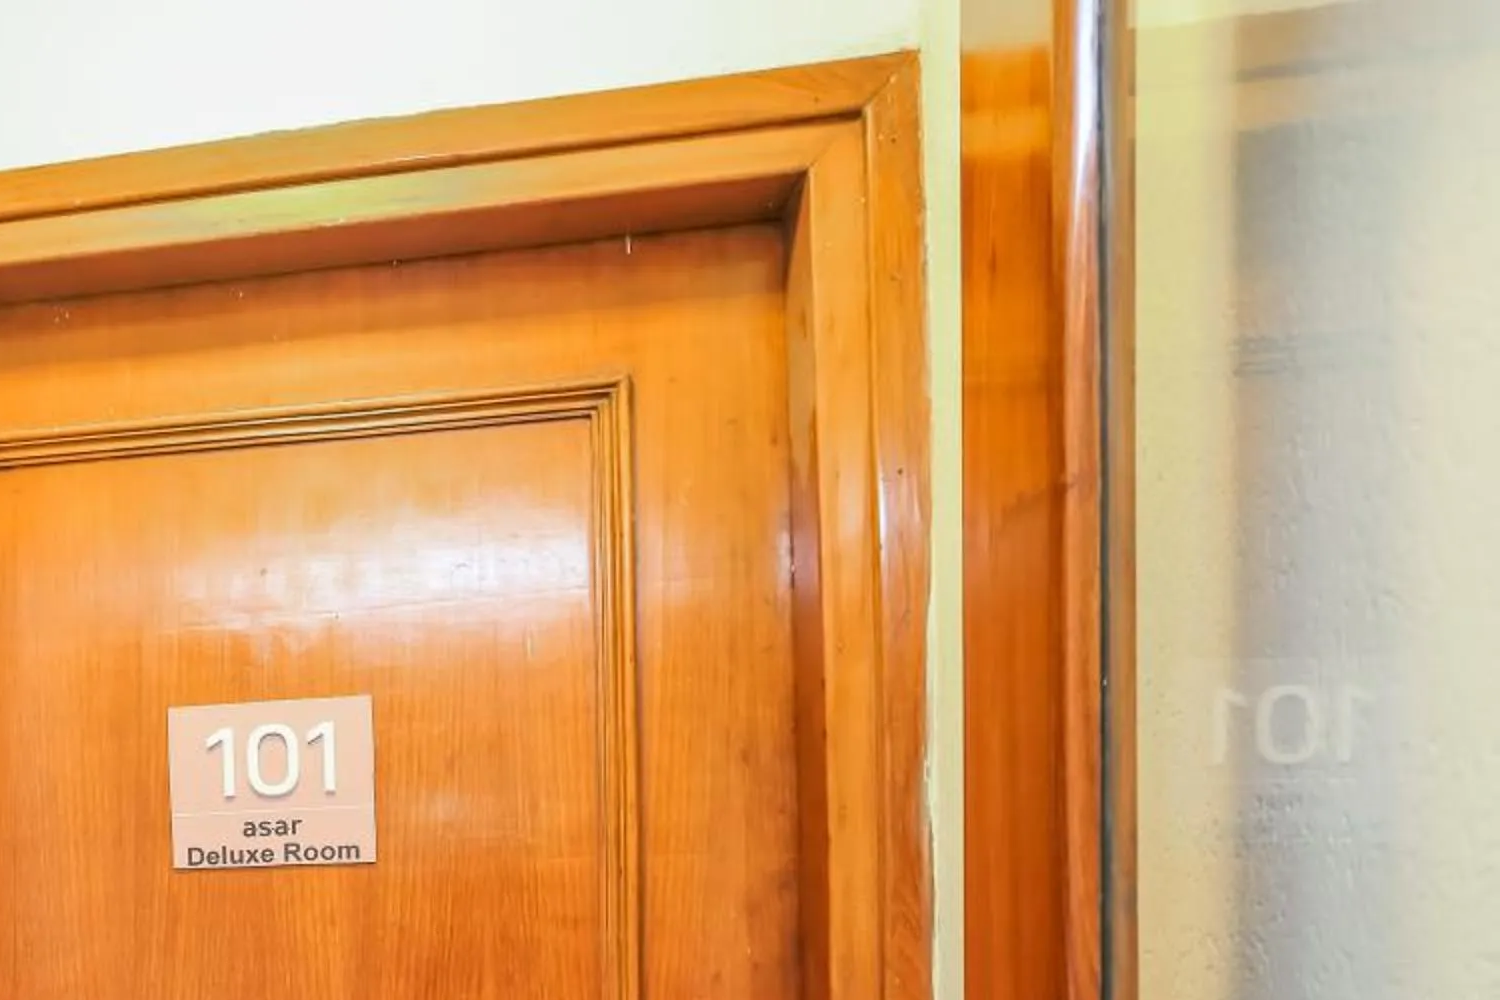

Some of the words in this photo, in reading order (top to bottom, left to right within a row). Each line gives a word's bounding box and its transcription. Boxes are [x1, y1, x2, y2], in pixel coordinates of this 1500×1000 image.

[206, 720, 337, 798] 101
[243, 818, 302, 837] asar
[187, 846, 275, 867] Deluxe
[284, 842, 361, 862] Room
